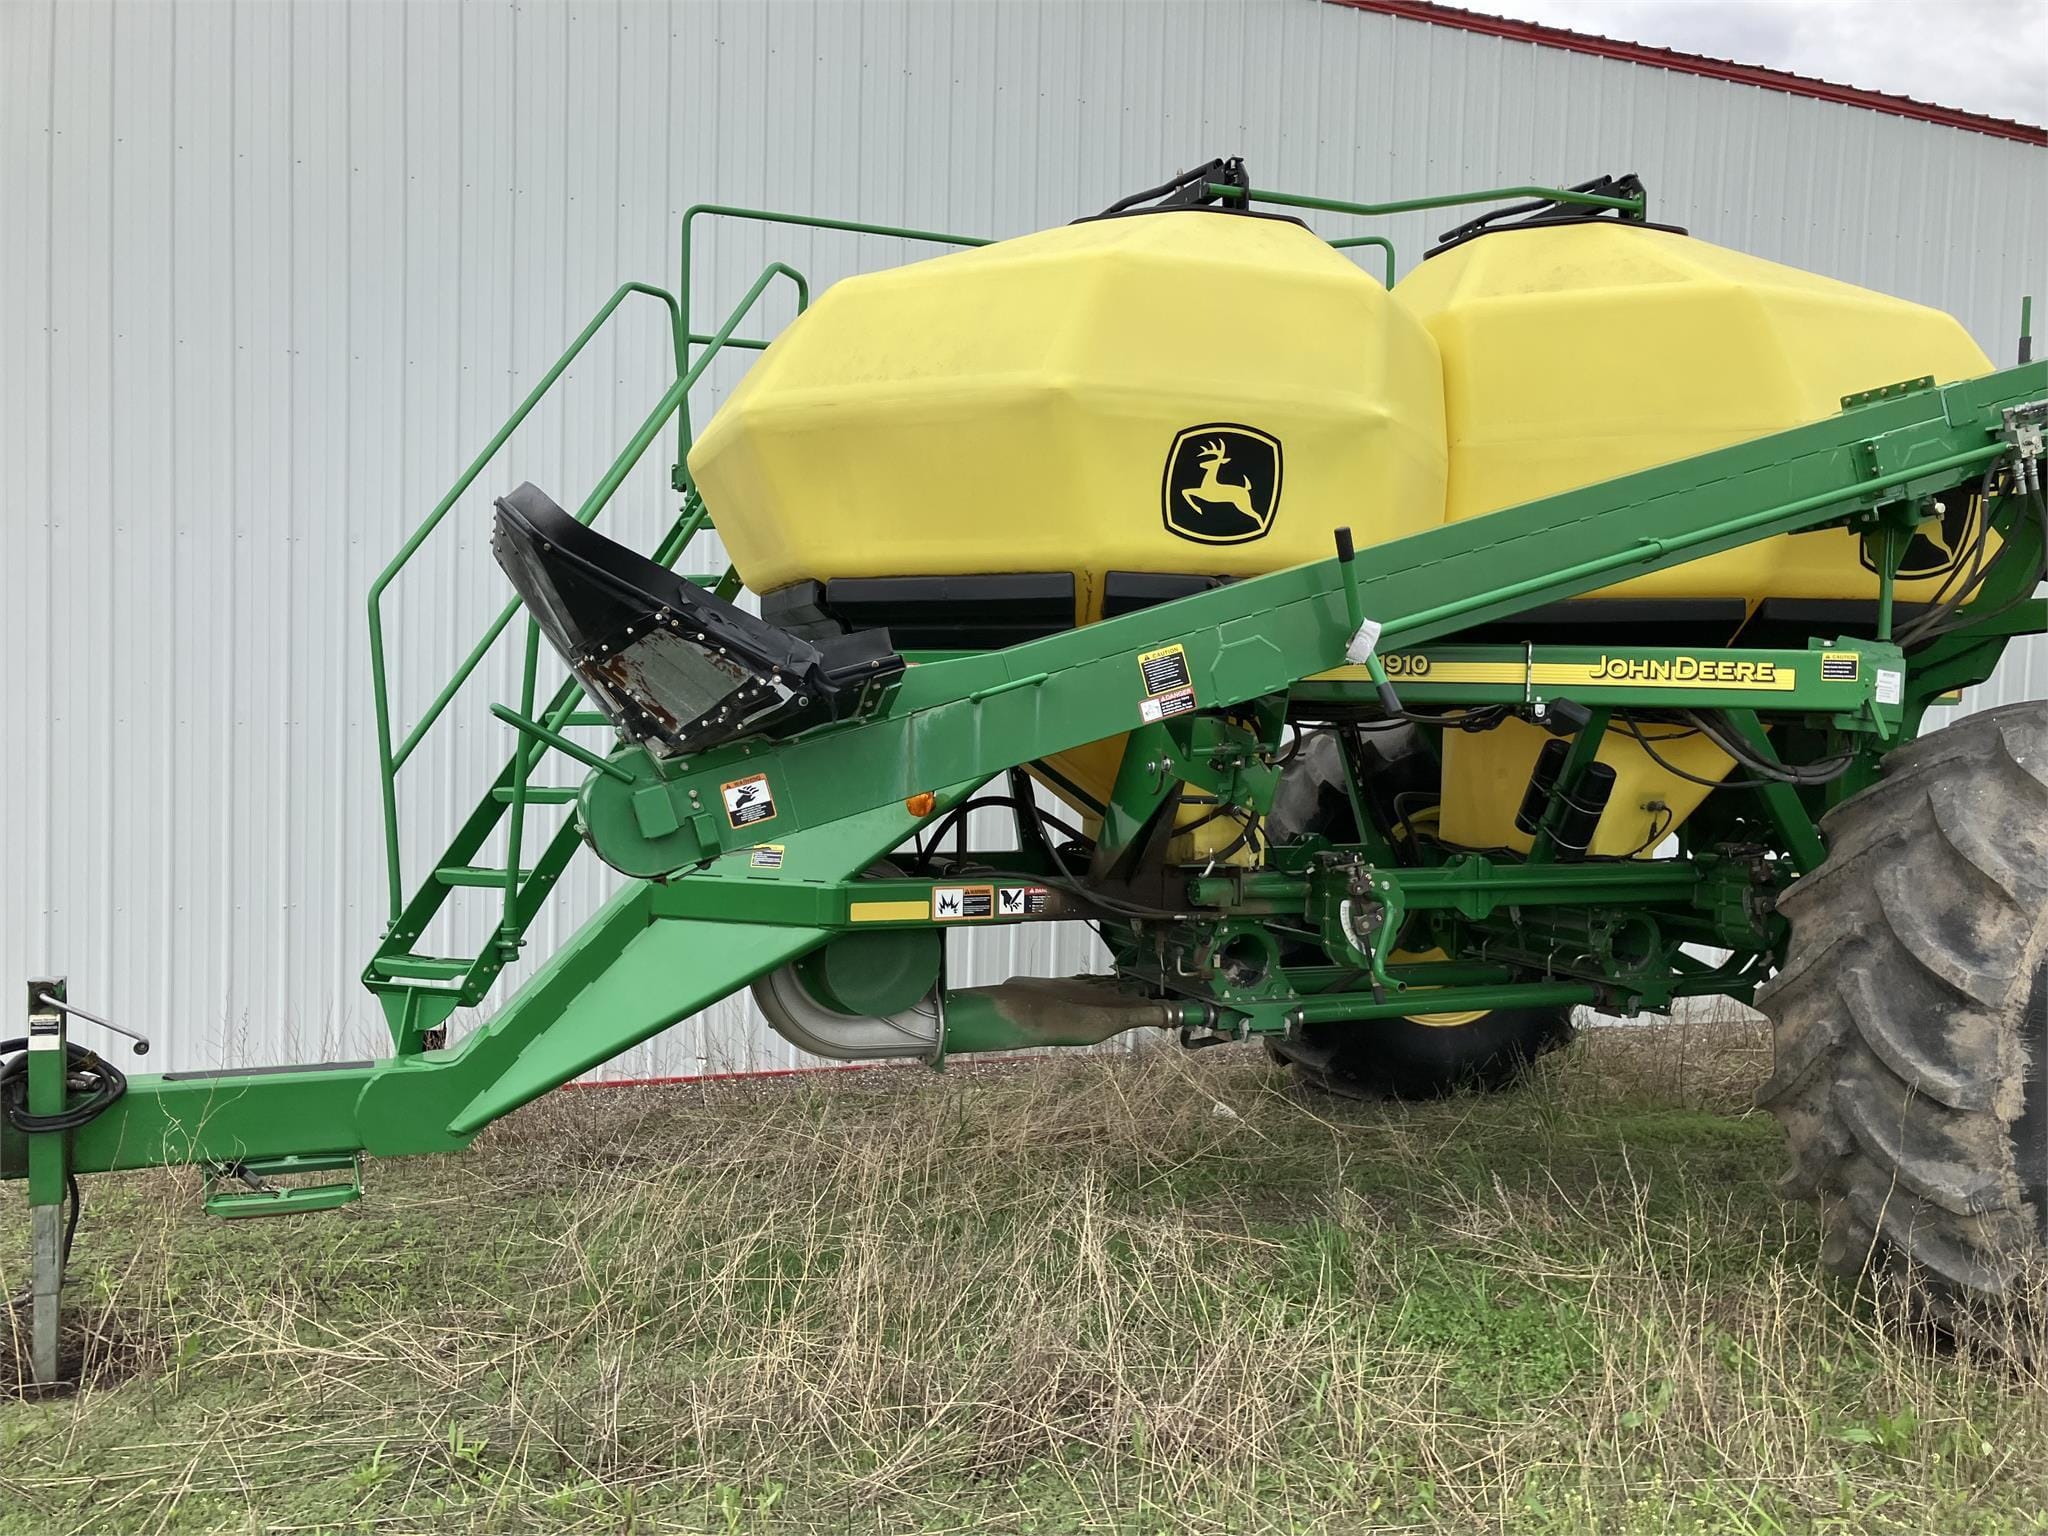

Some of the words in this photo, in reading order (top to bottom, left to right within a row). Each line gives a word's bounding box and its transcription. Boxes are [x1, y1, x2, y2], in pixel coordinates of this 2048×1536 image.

[1152, 647, 1179, 657] CAUTION
[1379, 653, 1430, 675] 1910
[1590, 655, 1671, 680] JOHN
[1675, 656, 1775, 682] DEERE
